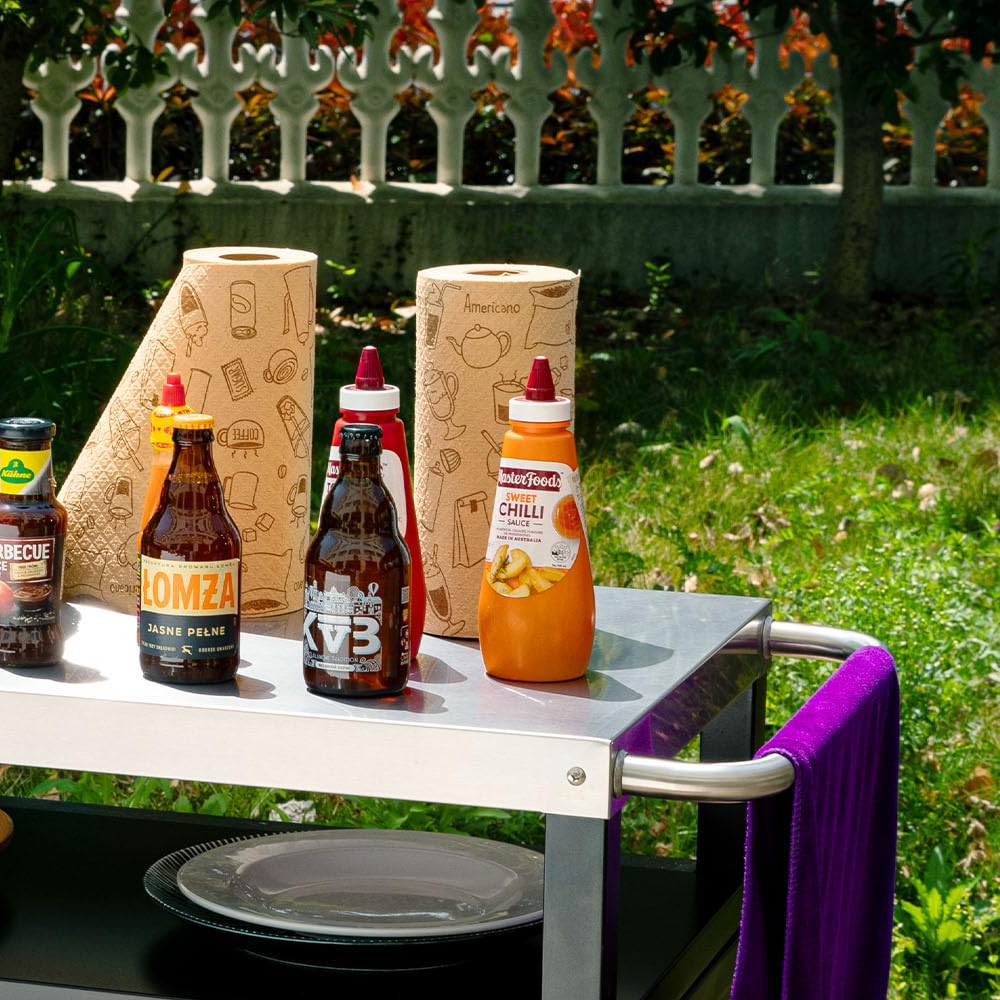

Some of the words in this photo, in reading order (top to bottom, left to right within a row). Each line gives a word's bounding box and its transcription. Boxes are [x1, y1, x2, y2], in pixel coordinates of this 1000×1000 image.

[463, 293, 521, 314] Americano
[228, 365, 247, 393] SUGAR
[232, 428, 259, 441] COFFEE
[1, 469, 32, 479] Kühne
[505, 492, 537, 504] SWEET
[499, 502, 545, 520] CHILLI
[507, 519, 530, 528] SAUCE
[147, 623, 183, 637] JASNE
[187, 626, 226, 637] PEŁNE
